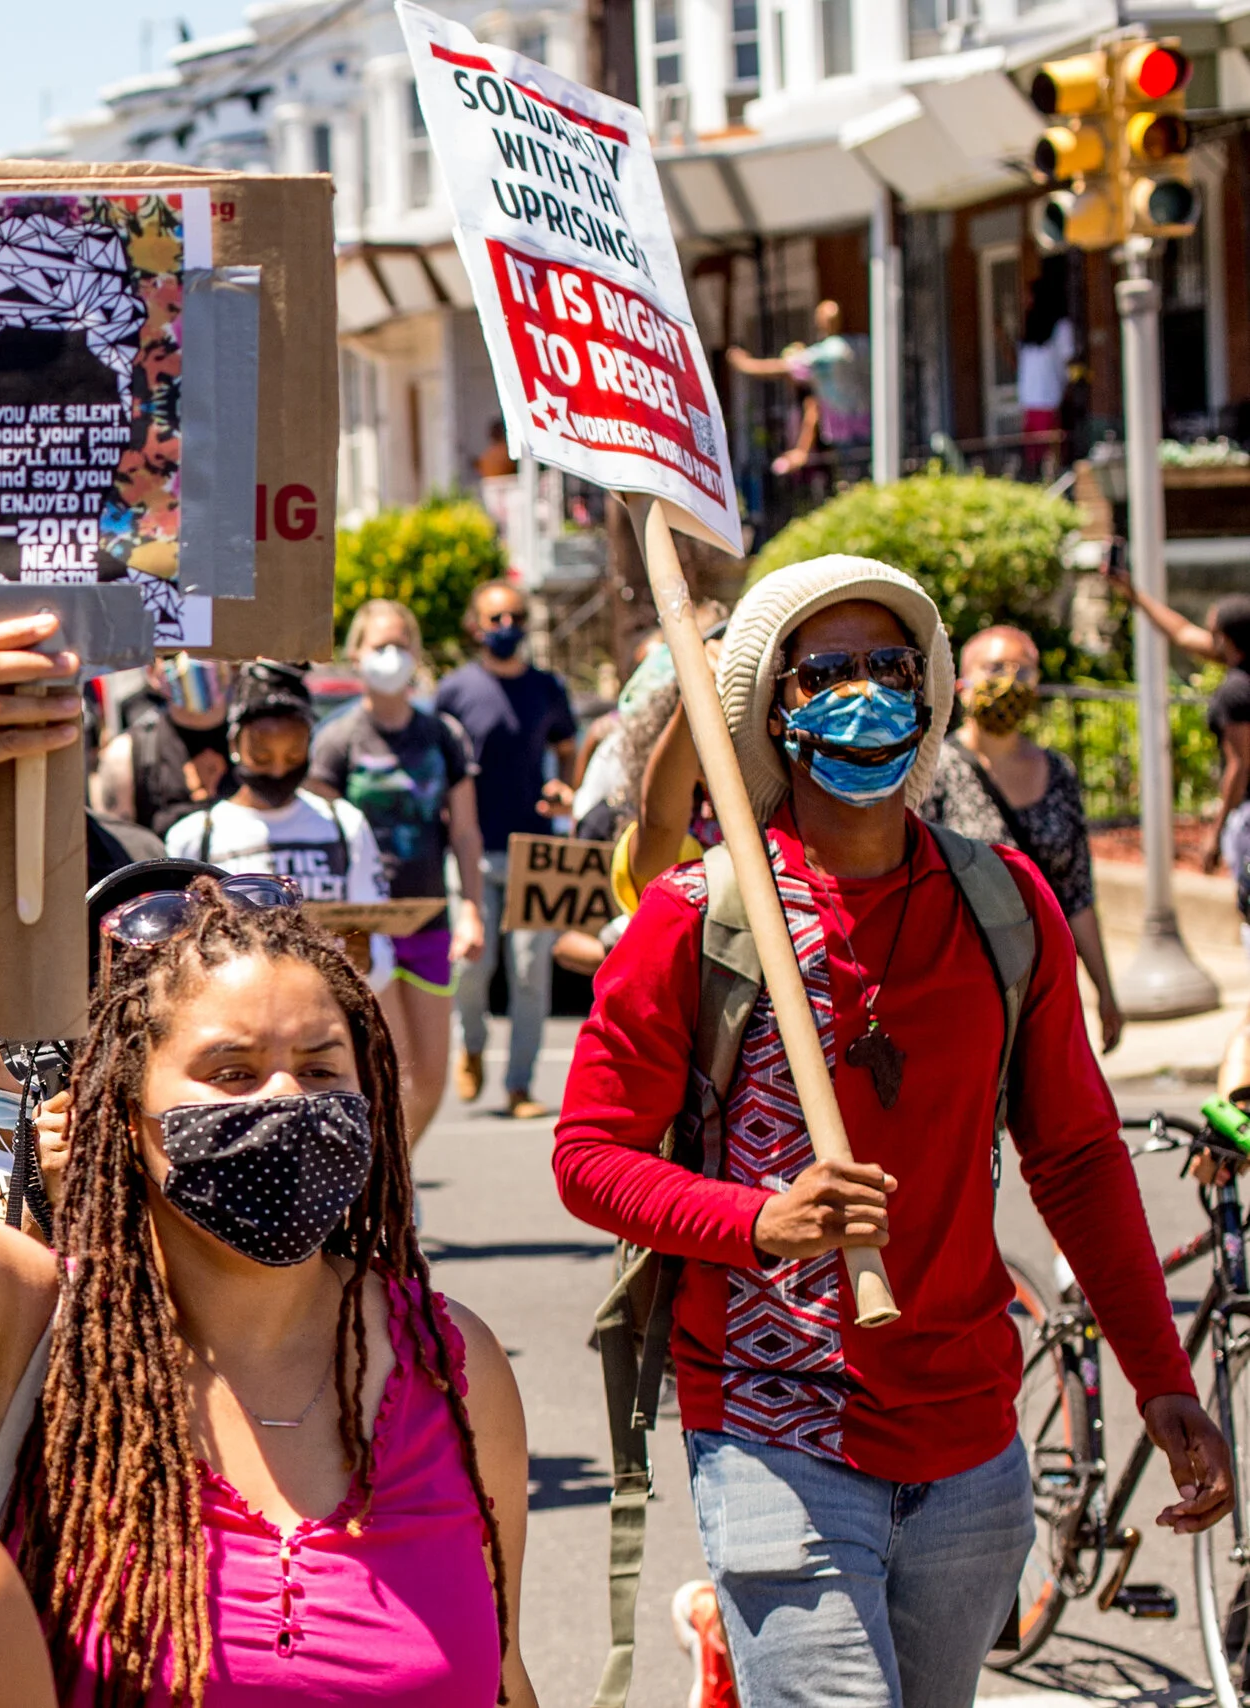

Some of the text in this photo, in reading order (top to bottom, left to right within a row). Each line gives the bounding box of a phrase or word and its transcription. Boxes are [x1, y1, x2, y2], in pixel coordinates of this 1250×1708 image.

[491, 127, 626, 222] WITH TH
[504, 252, 686, 373] IT IS RIGHT
[525, 322, 690, 428] TO REBEL
[28, 405, 60, 423] ARE
[65, 404, 121, 423] SILENT
[39, 427, 84, 448] your
[88, 422, 131, 448] pain
[570, 412, 654, 453] WORKERS
[651, 430, 695, 475] WORLD
[50, 447, 86, 466] KILL
[89, 447, 120, 465] YOU
[32, 470, 70, 491] say
[74, 470, 112, 491] you
[0, 493, 102, 514] ENJOYED IT
[21, 544, 98, 569] NEALE
[529, 842, 607, 876] BLA
